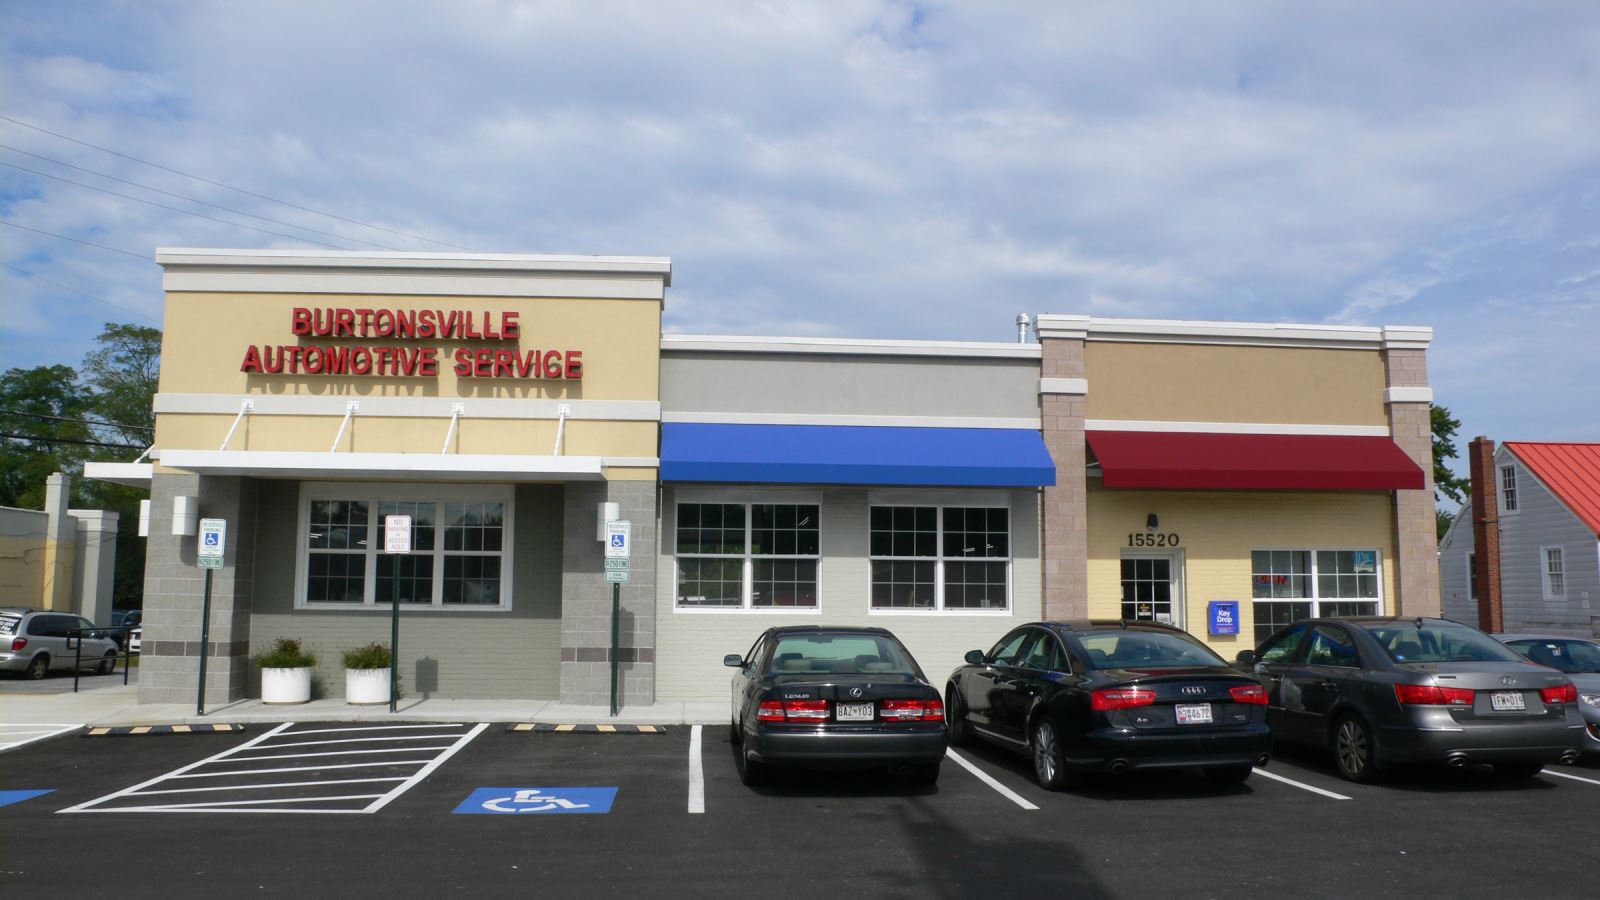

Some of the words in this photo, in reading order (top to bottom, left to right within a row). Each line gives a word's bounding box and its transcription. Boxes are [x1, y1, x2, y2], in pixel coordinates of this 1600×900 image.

[292, 307, 520, 339] BURTONSVILLE
[240, 345, 438, 376] AUTOMOTIVE
[454, 348, 583, 379] SERVICE
[1127, 533, 1180, 547] 15520
[1216, 616, 1233, 624] Drop
